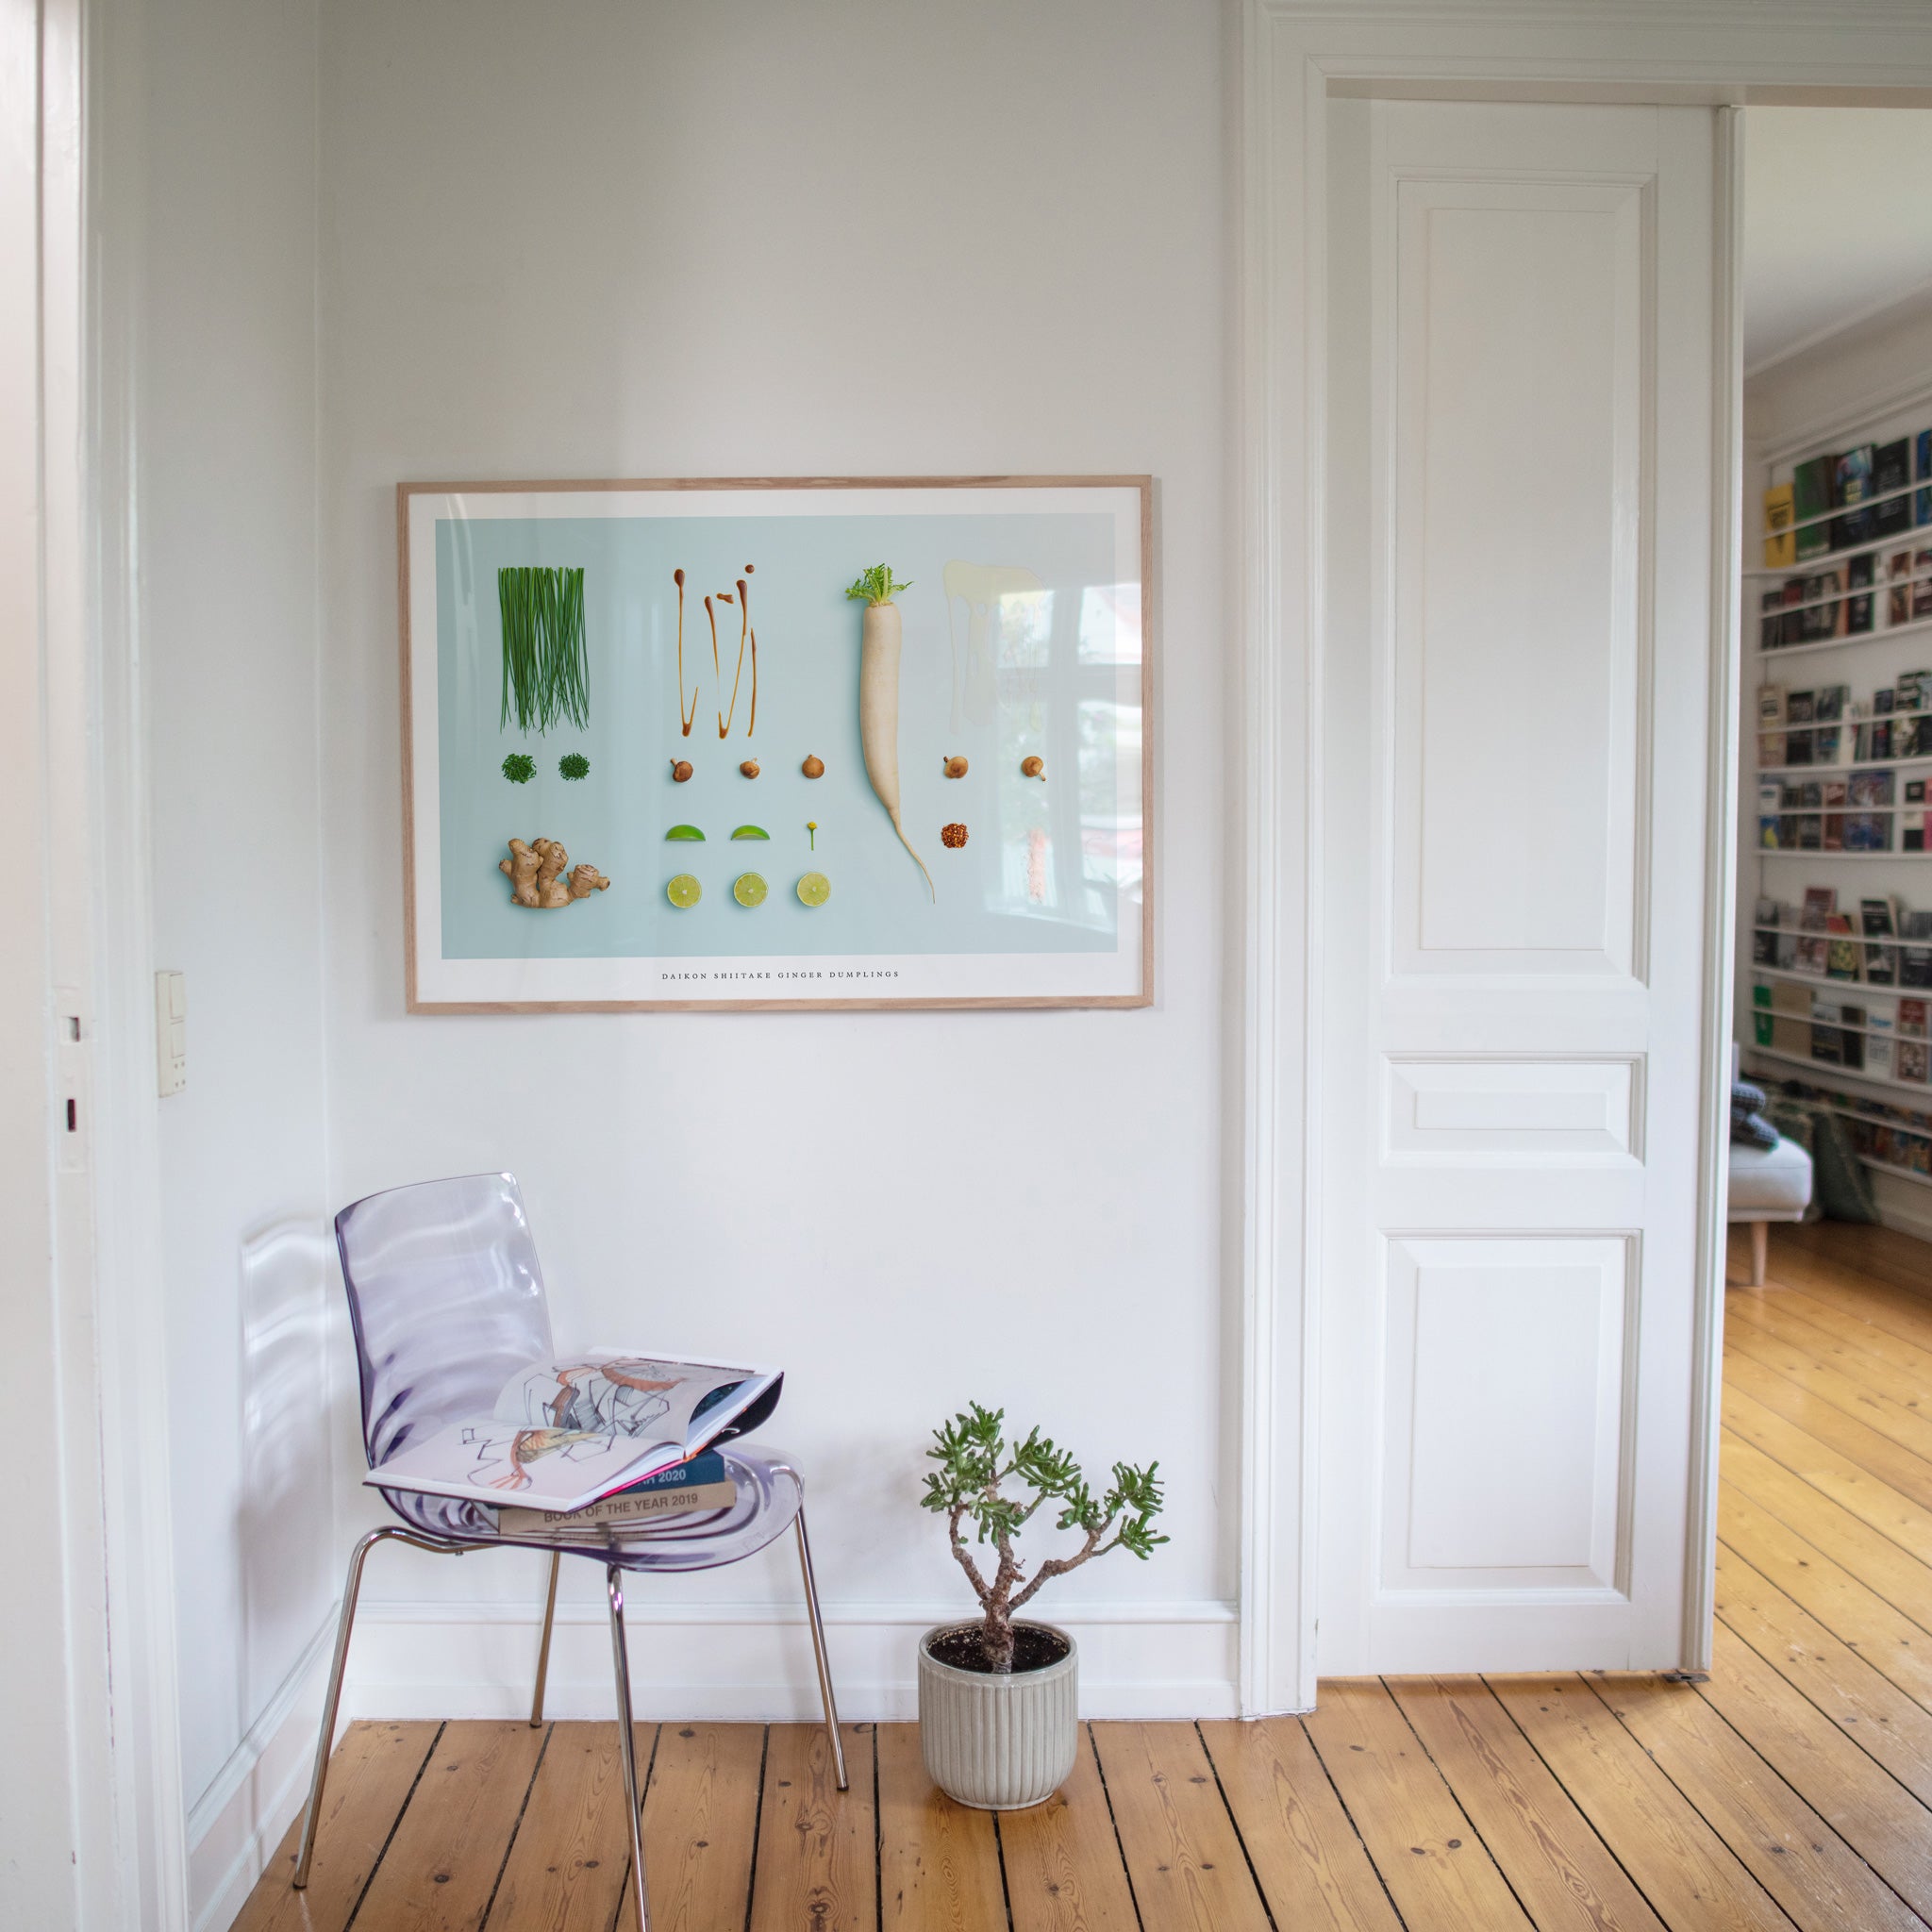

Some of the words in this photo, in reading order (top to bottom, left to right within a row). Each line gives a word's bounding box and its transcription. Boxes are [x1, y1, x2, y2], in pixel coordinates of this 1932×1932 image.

[658, 1469, 687, 1483] 2020
[585, 1506, 603, 1517] OF
[607, 1501, 631, 1514] THE
[634, 1497, 669, 1510] YEAR
[672, 1493, 698, 1506] 2019
